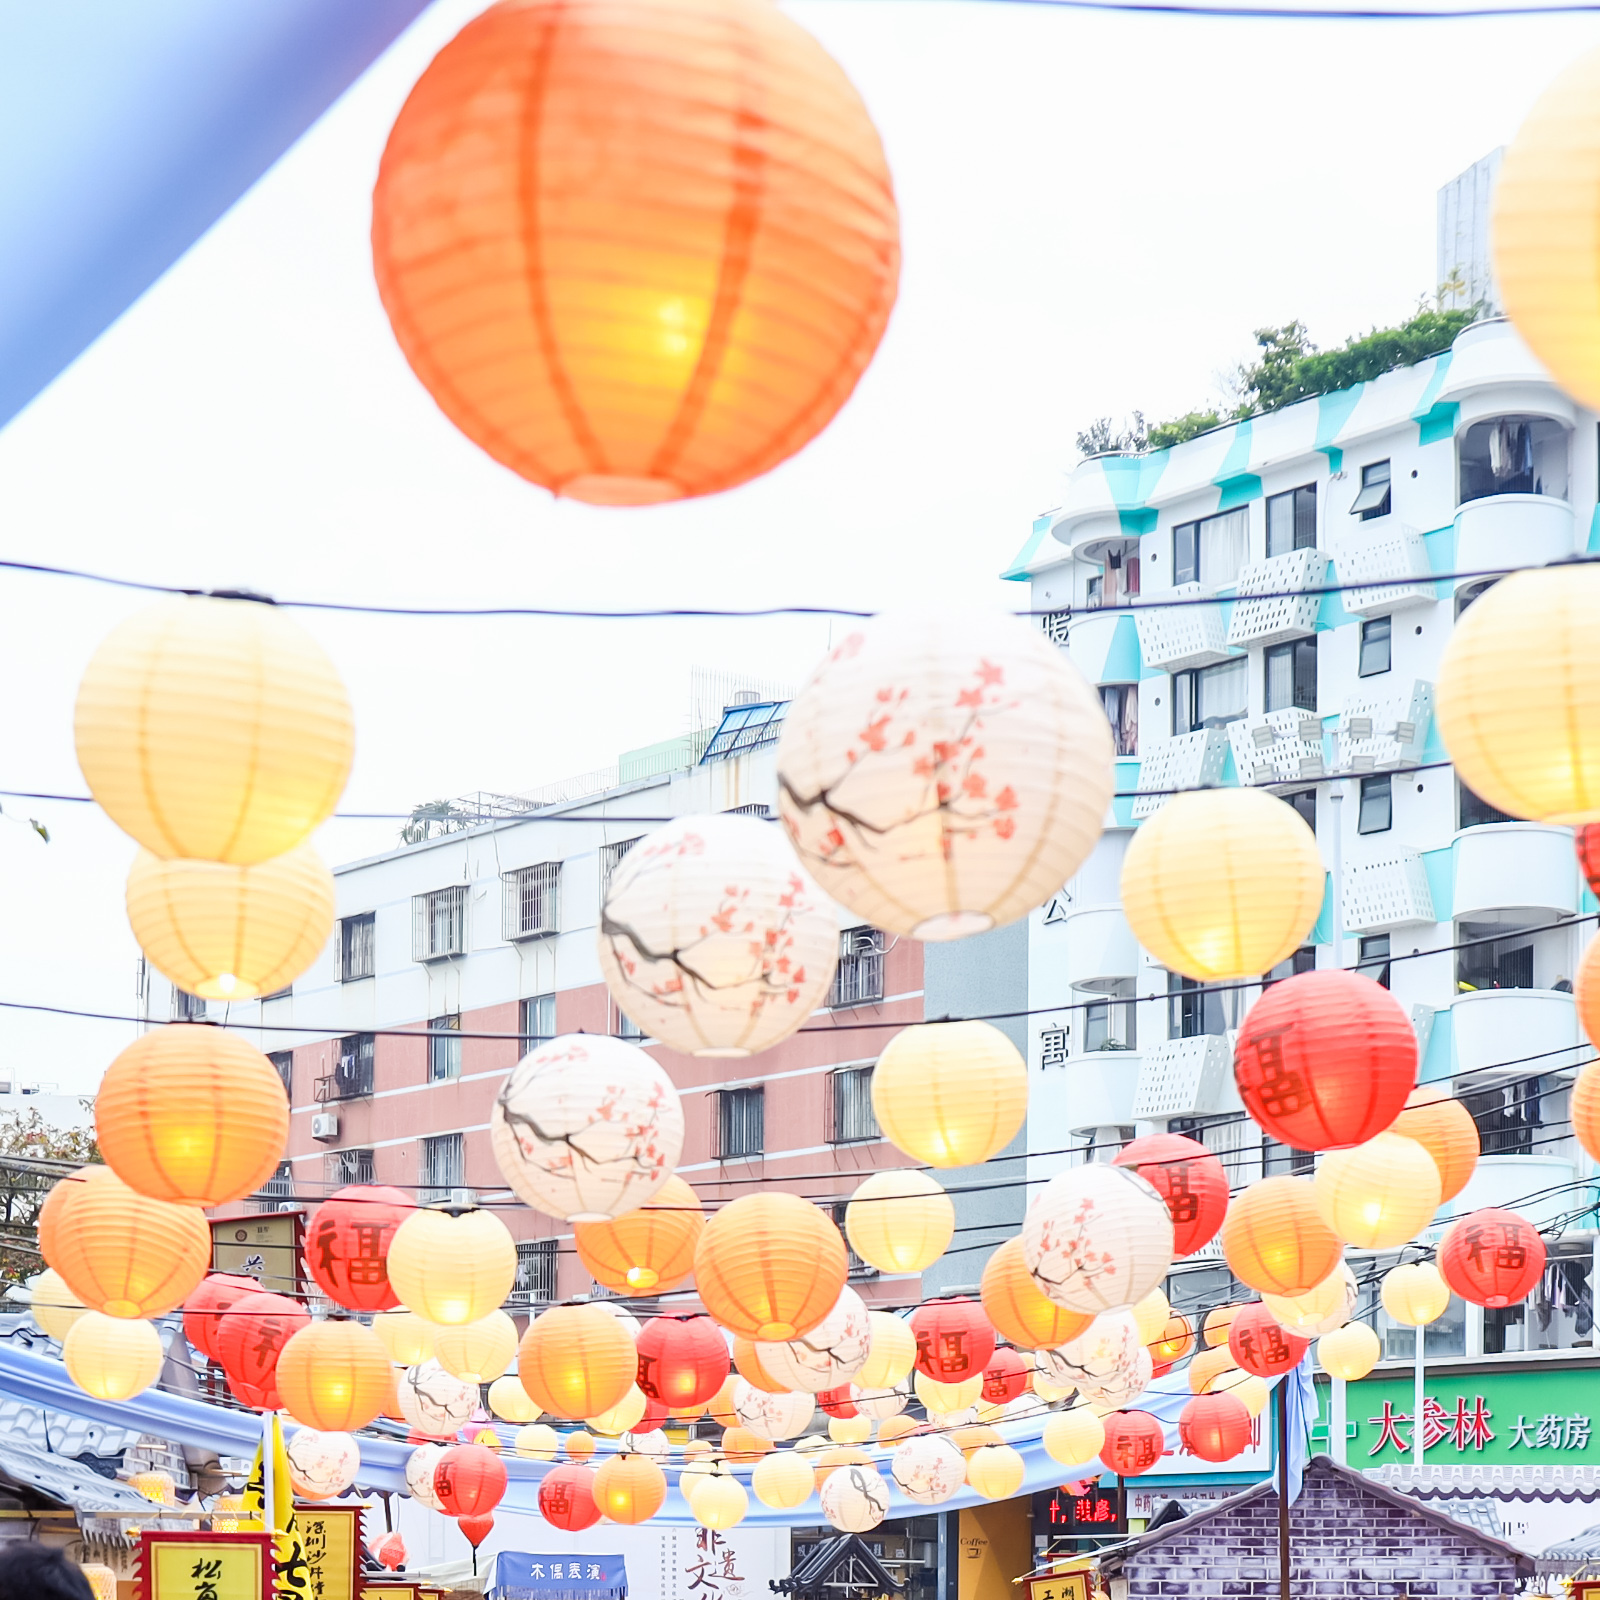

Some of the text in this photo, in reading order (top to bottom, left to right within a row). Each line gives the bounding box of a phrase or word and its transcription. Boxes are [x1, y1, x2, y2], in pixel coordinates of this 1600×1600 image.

[317, 1219, 390, 1290] 福
[1464, 1223, 1527, 1274] 福
[917, 1331, 968, 1374] 福
[1239, 1325, 1290, 1370] 福
[1368, 1395, 1592, 1456] 大参林 大药房
[1117, 1435, 1157, 1469] 福
[960, 1537, 988, 1546] Coffee
[531, 1563, 601, 1580] 木偶表演
